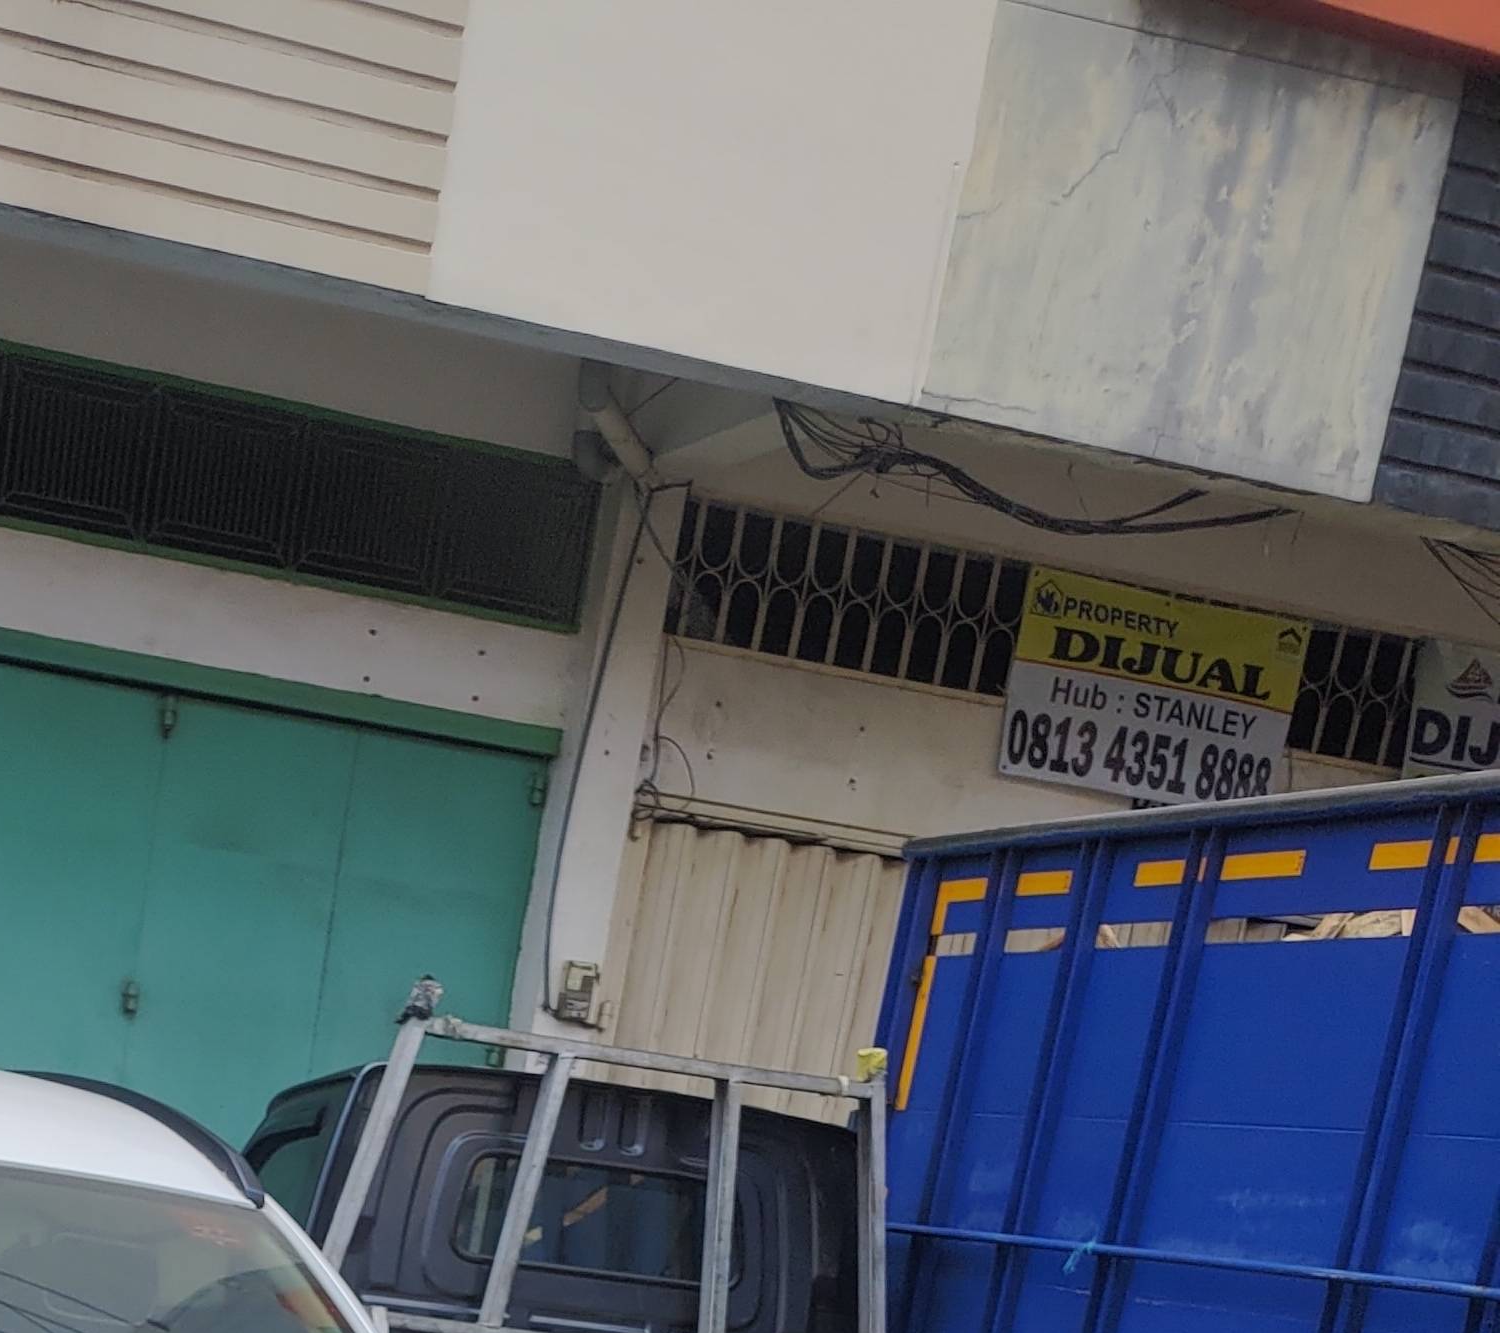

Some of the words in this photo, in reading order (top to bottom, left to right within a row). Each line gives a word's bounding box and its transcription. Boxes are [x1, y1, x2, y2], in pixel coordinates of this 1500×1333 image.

[1062, 596, 1180, 638] PROPERTY
[1050, 626, 1271, 700] DIJUAL
[1051, 676, 1107, 711] Hub
[1133, 692, 1258, 740] STANLEY
[1411, 707, 1500, 766] DIJ
[1007, 709, 1098, 778] 0813
[1103, 725, 1189, 795] 4351
[1194, 743, 1272, 801] 8888
